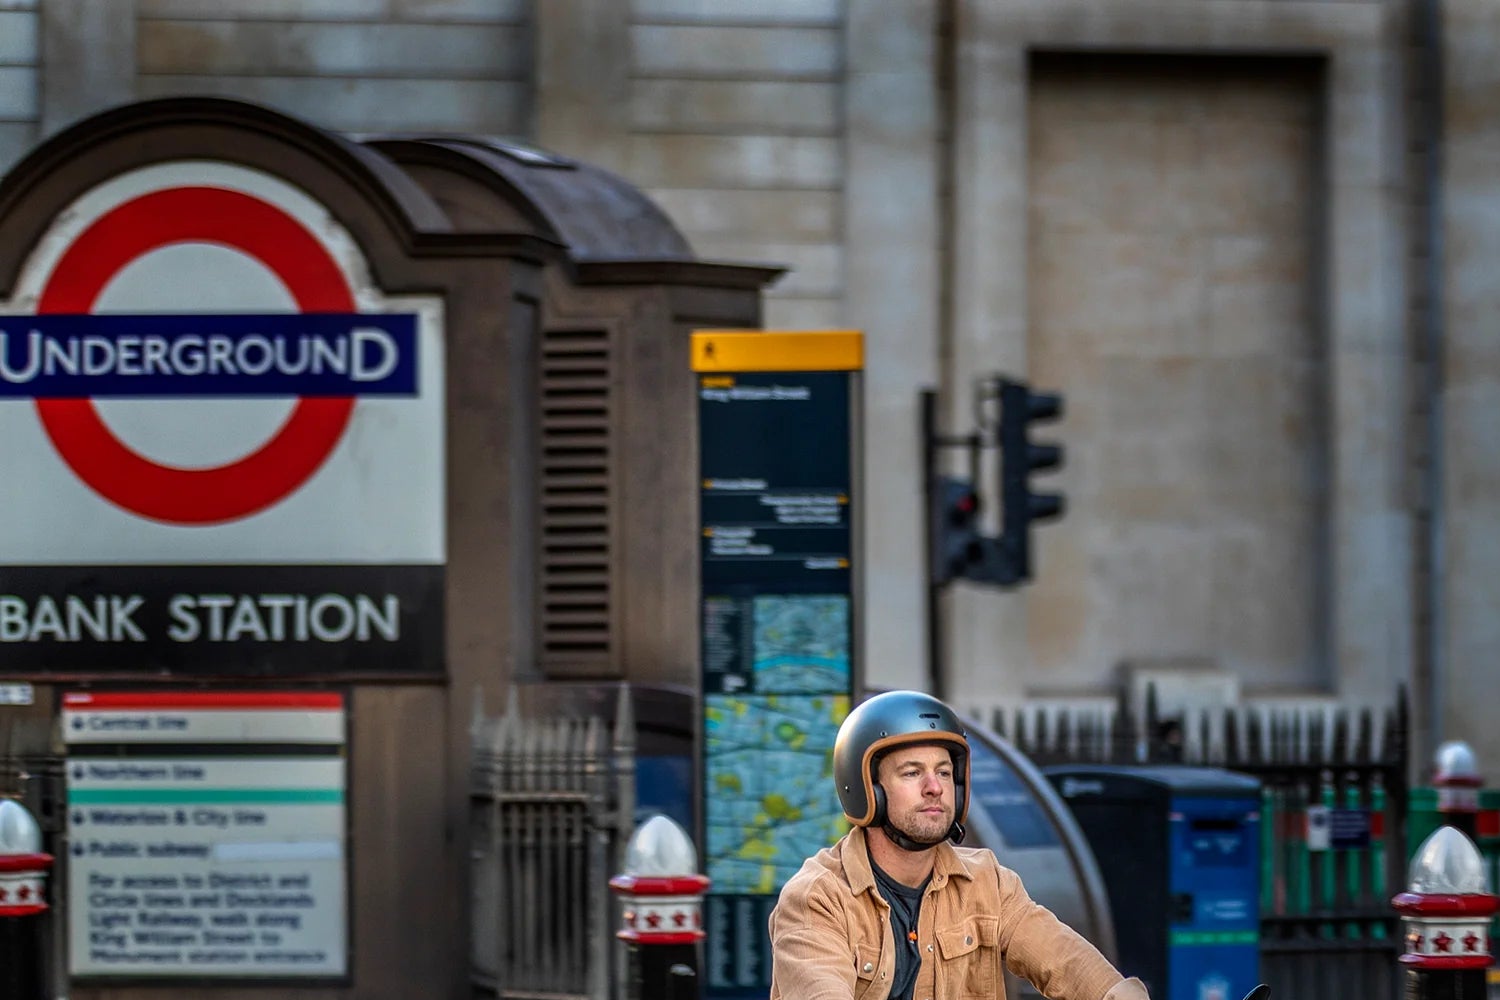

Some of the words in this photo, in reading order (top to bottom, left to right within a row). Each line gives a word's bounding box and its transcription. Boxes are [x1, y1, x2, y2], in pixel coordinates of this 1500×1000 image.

[0, 329, 399, 383] UNDERGROUND
[0, 594, 147, 642] BANK
[167, 593, 400, 642] STATION
